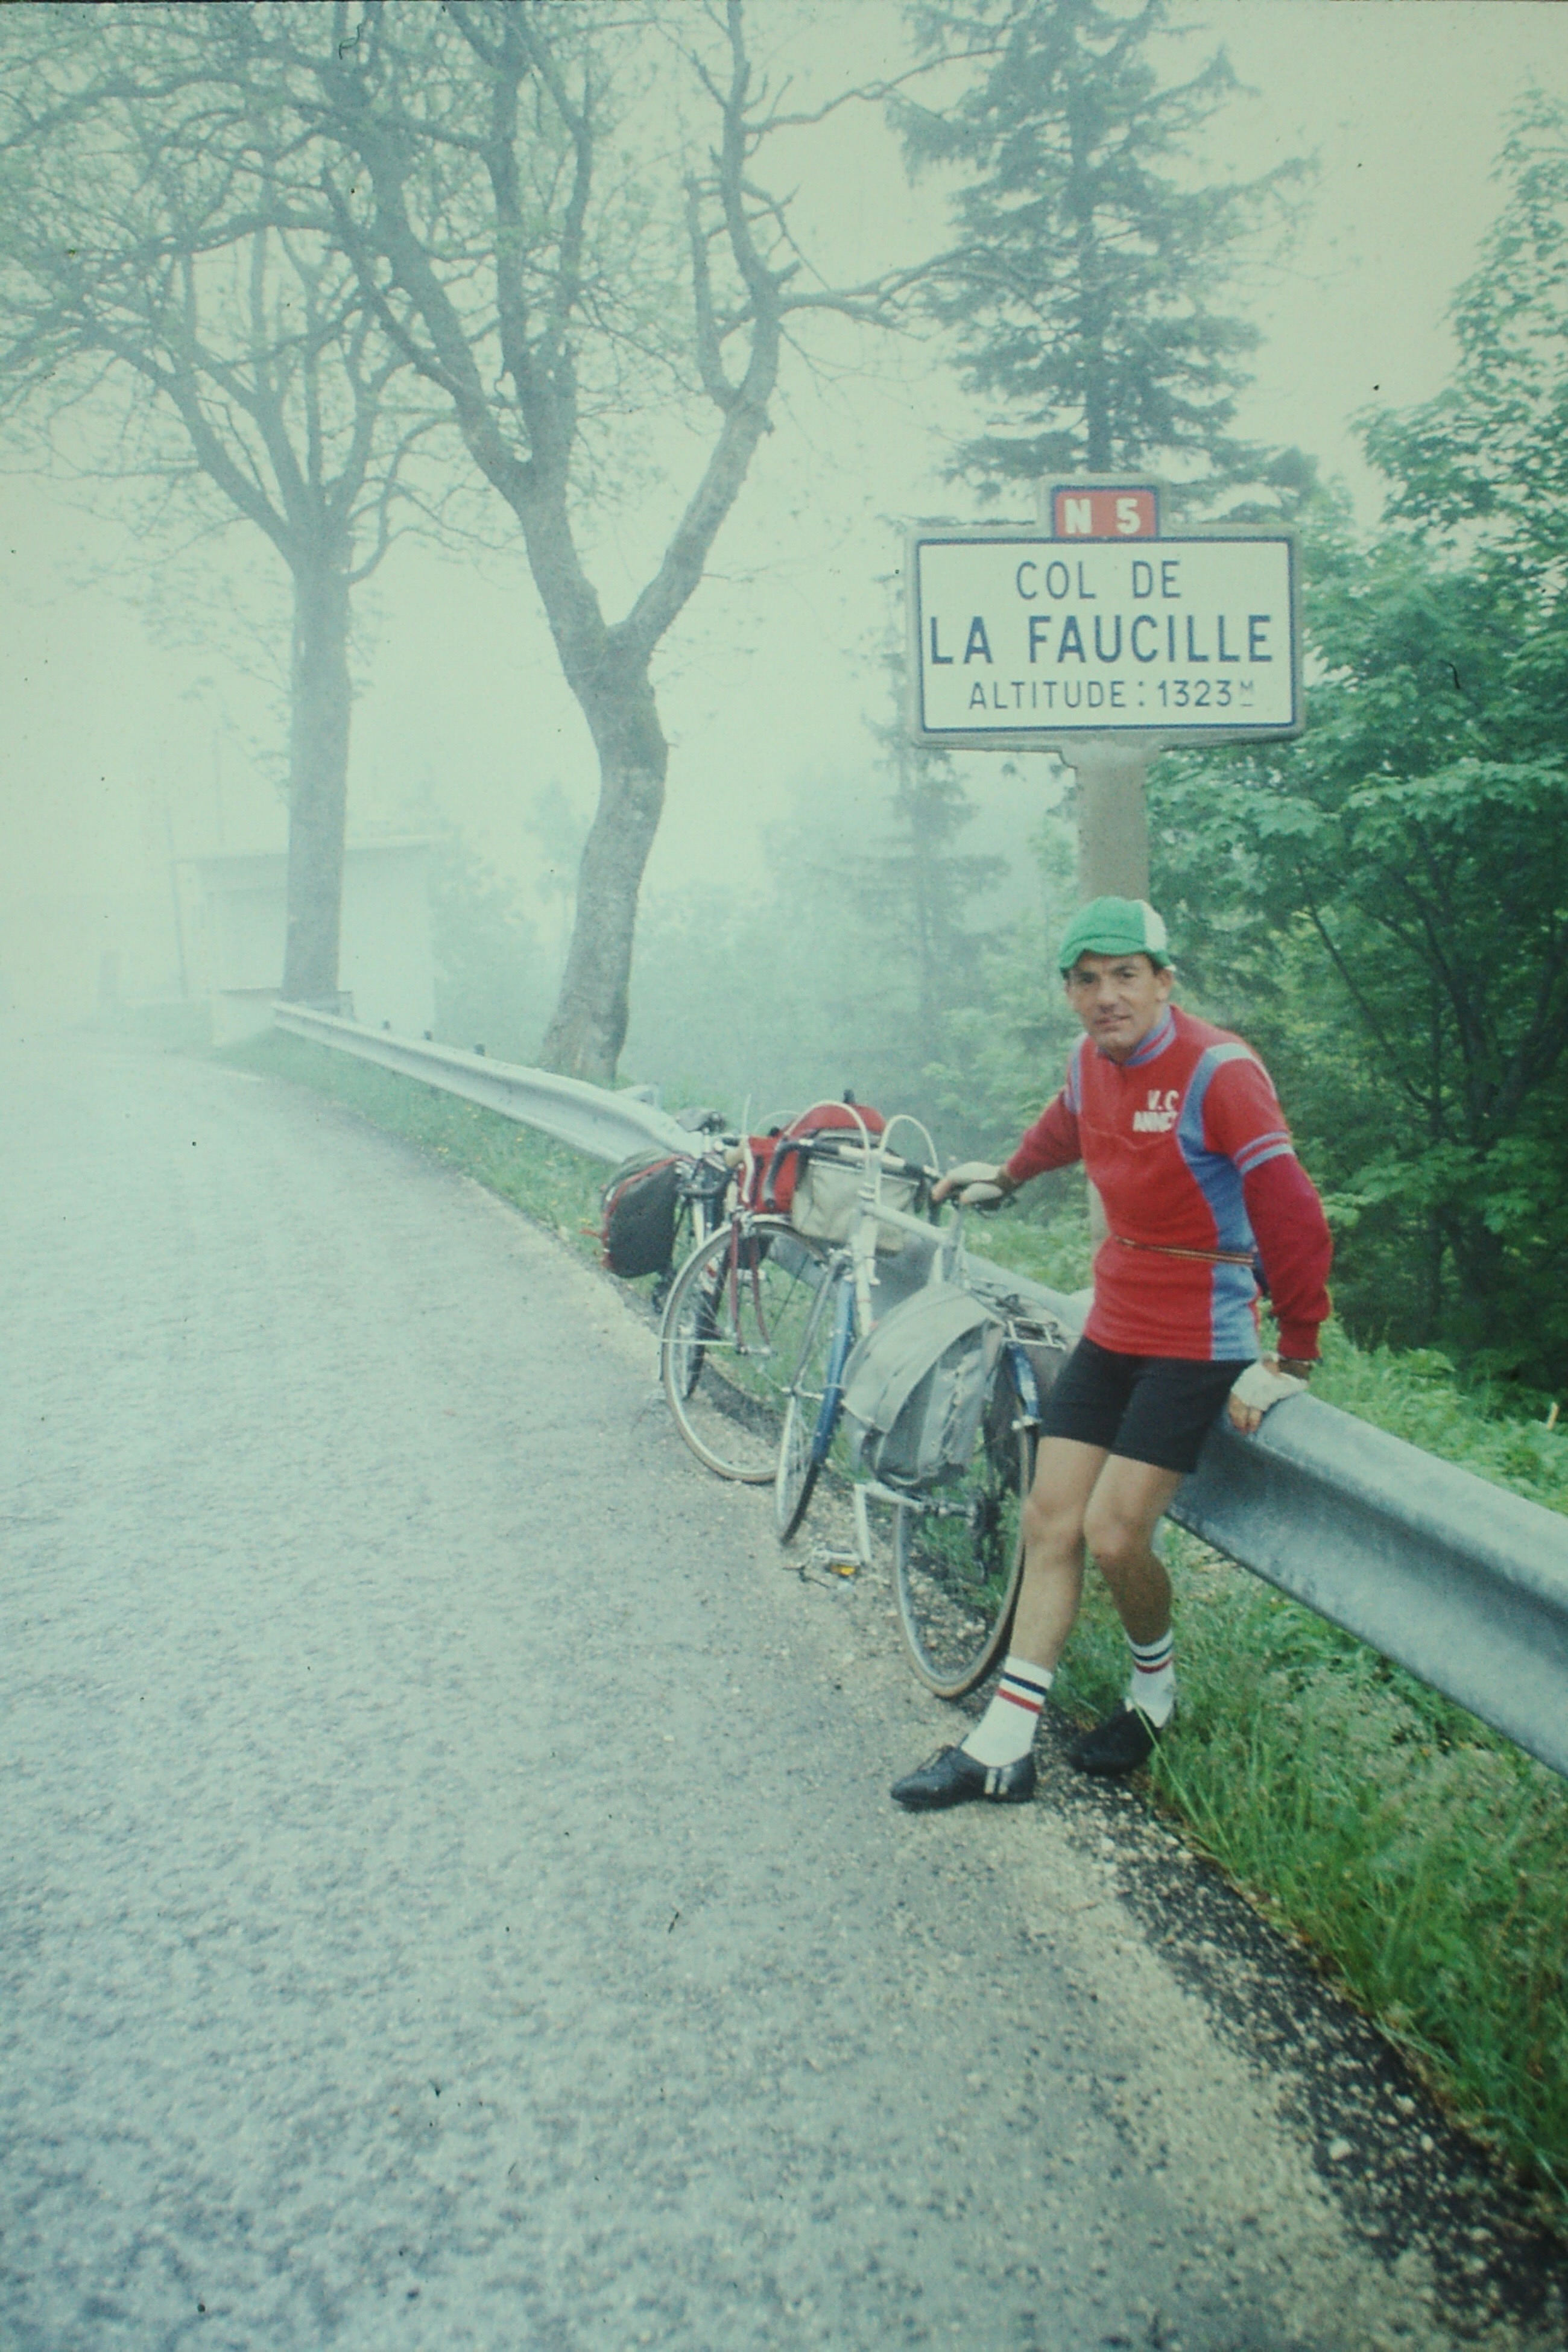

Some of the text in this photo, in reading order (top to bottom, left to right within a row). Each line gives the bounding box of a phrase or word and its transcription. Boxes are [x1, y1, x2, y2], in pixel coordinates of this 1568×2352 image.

[1064, 498, 1142, 535] N 5
[1016, 560, 1182, 600] COL DE
[930, 614, 1273, 665] LA FAUCILLE
